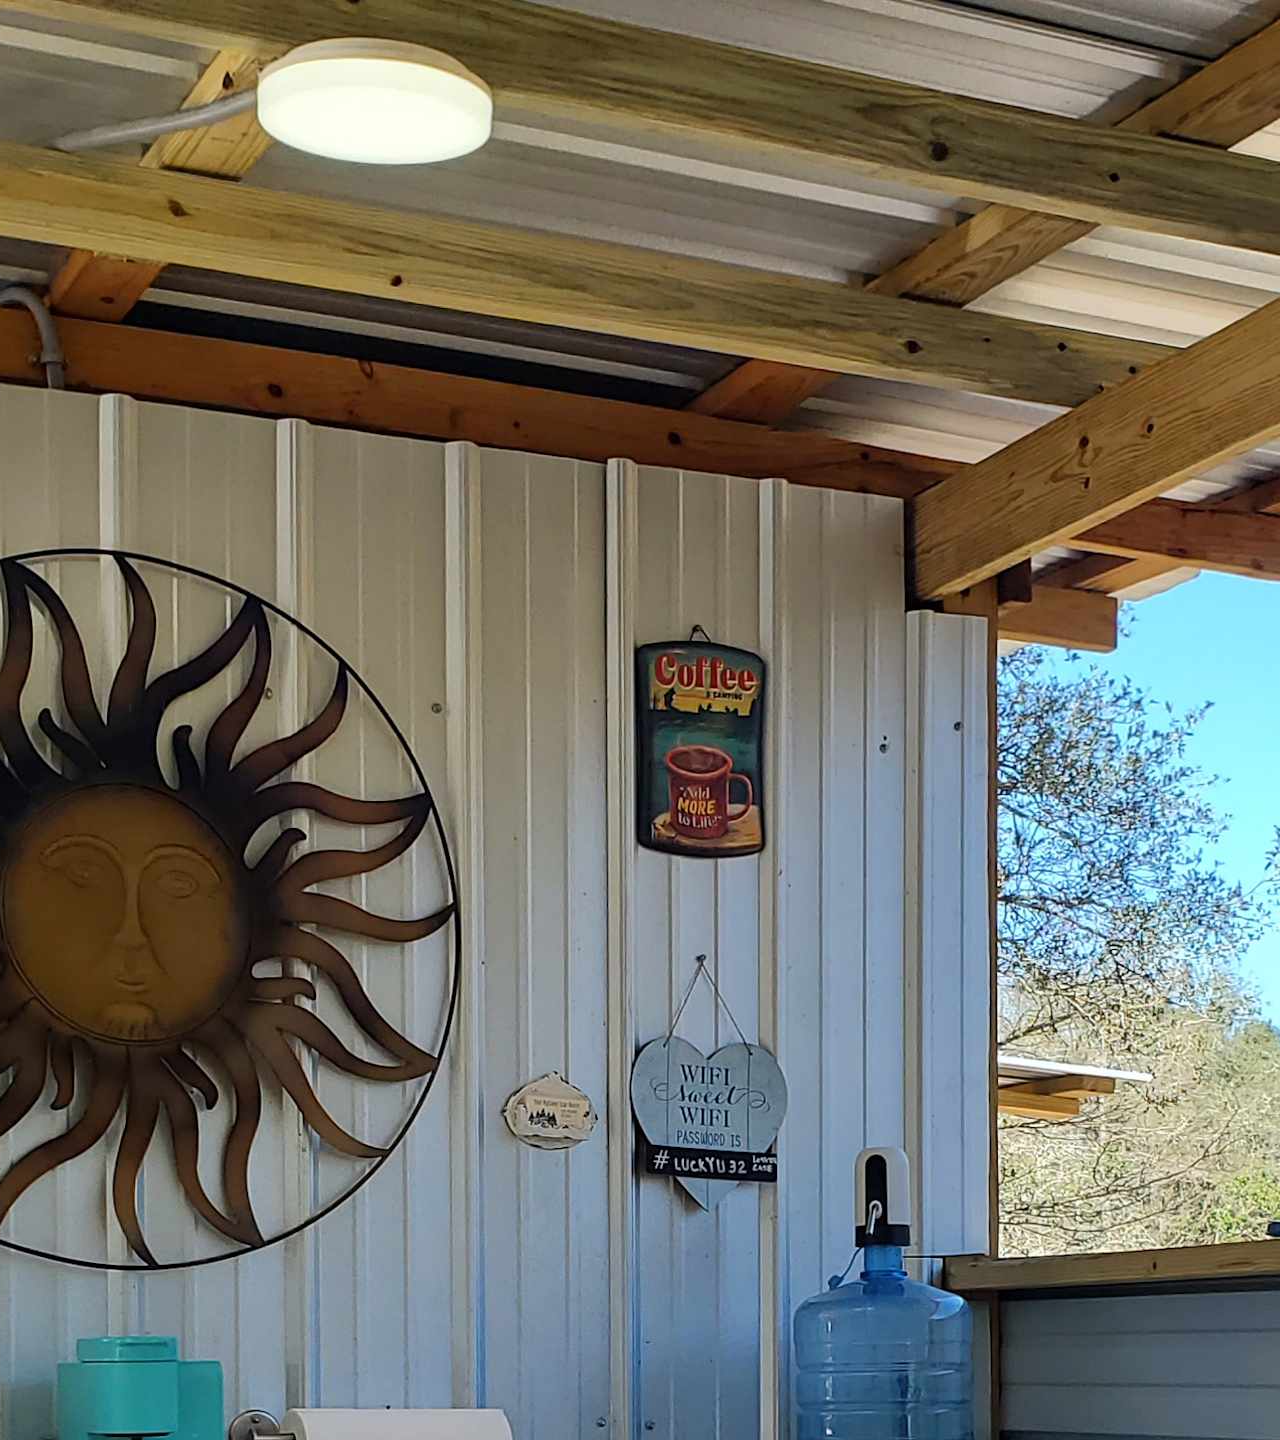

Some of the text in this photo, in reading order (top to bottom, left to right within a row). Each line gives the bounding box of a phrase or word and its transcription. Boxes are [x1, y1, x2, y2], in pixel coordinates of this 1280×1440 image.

[654, 655, 758, 692] Coffee
[678, 797, 716, 815] MORE
[680, 1064, 730, 1086] WIFI
[680, 1106, 730, 1128] WIFI
[677, 1130, 742, 1147] PASSWORD IS
